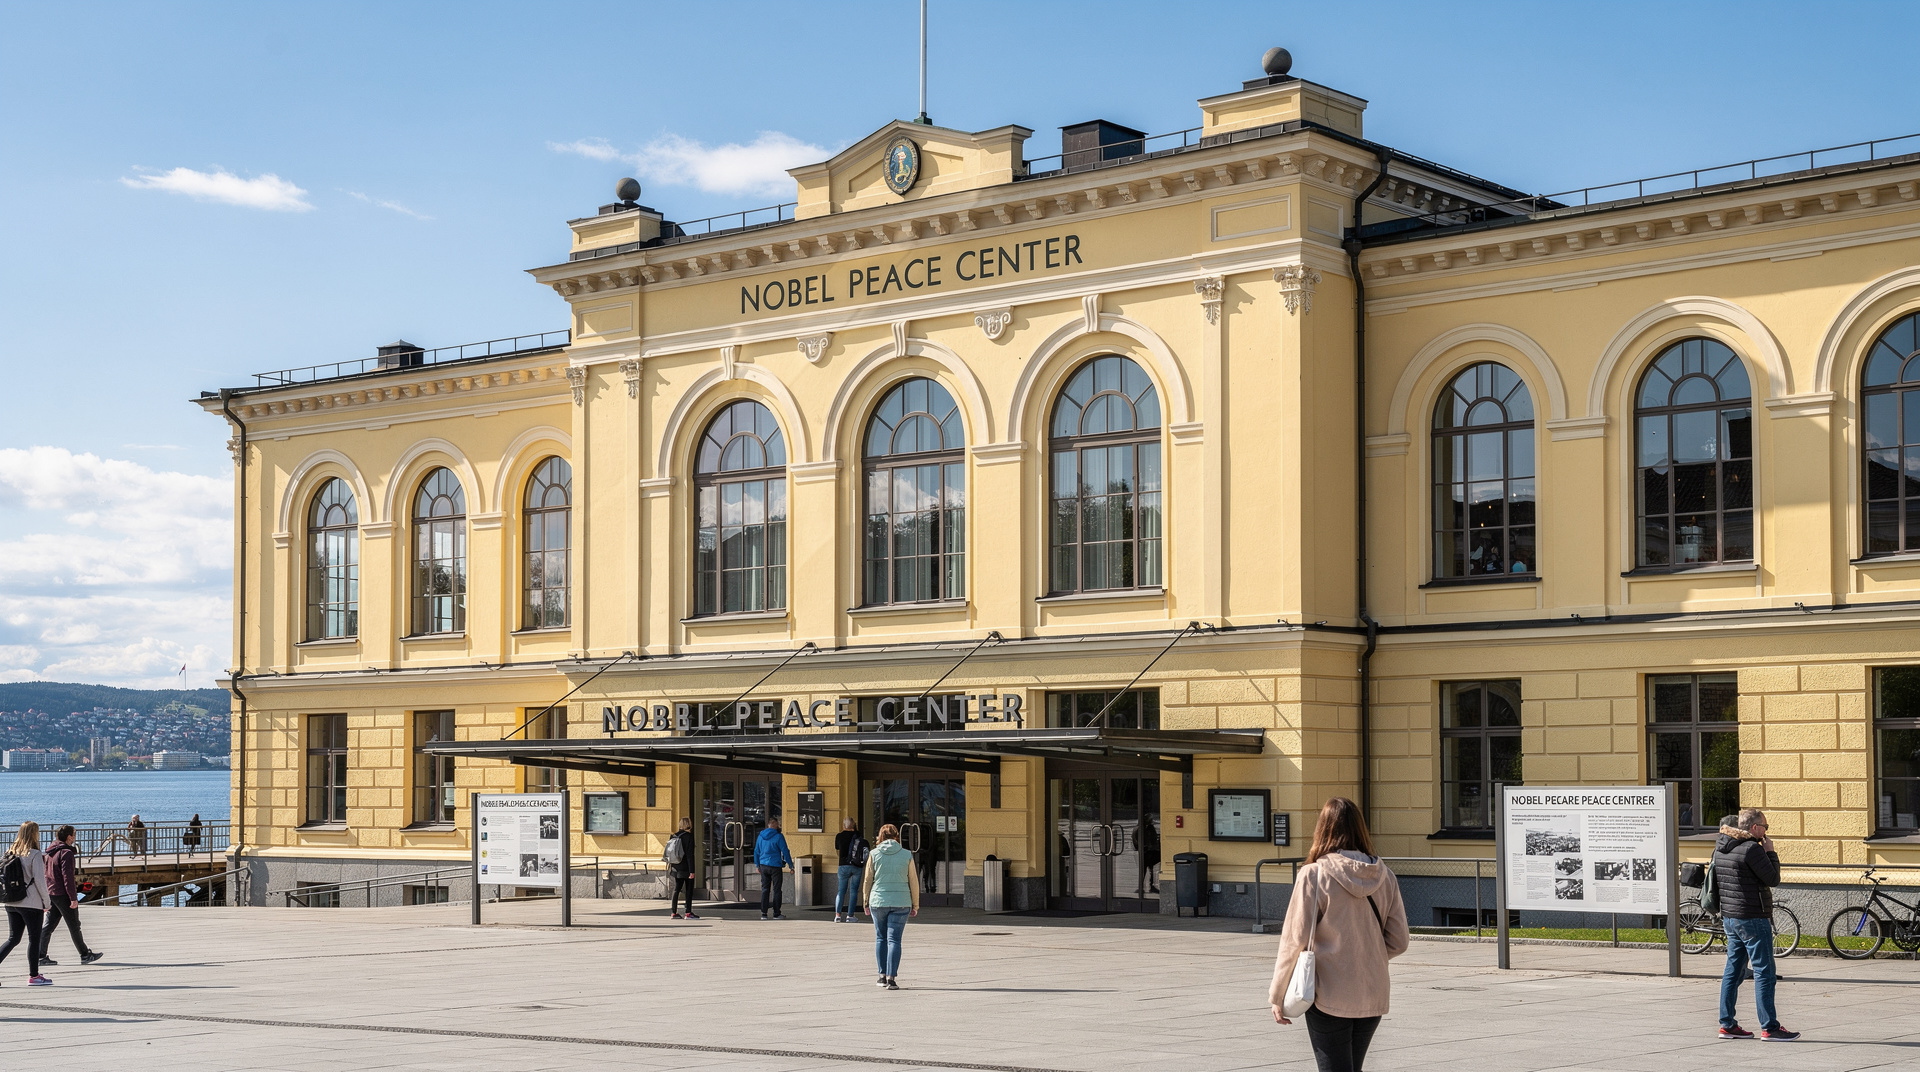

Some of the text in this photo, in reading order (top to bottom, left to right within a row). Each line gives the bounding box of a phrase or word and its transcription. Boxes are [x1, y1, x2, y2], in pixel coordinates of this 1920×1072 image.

[742, 234, 1084, 314] NOBEL PEACE CENTER
[736, 699, 853, 729] PEACE
[876, 693, 1024, 726] CENTER
[1511, 795, 1655, 805] NOBEL PECARE PEACE CENTRER
